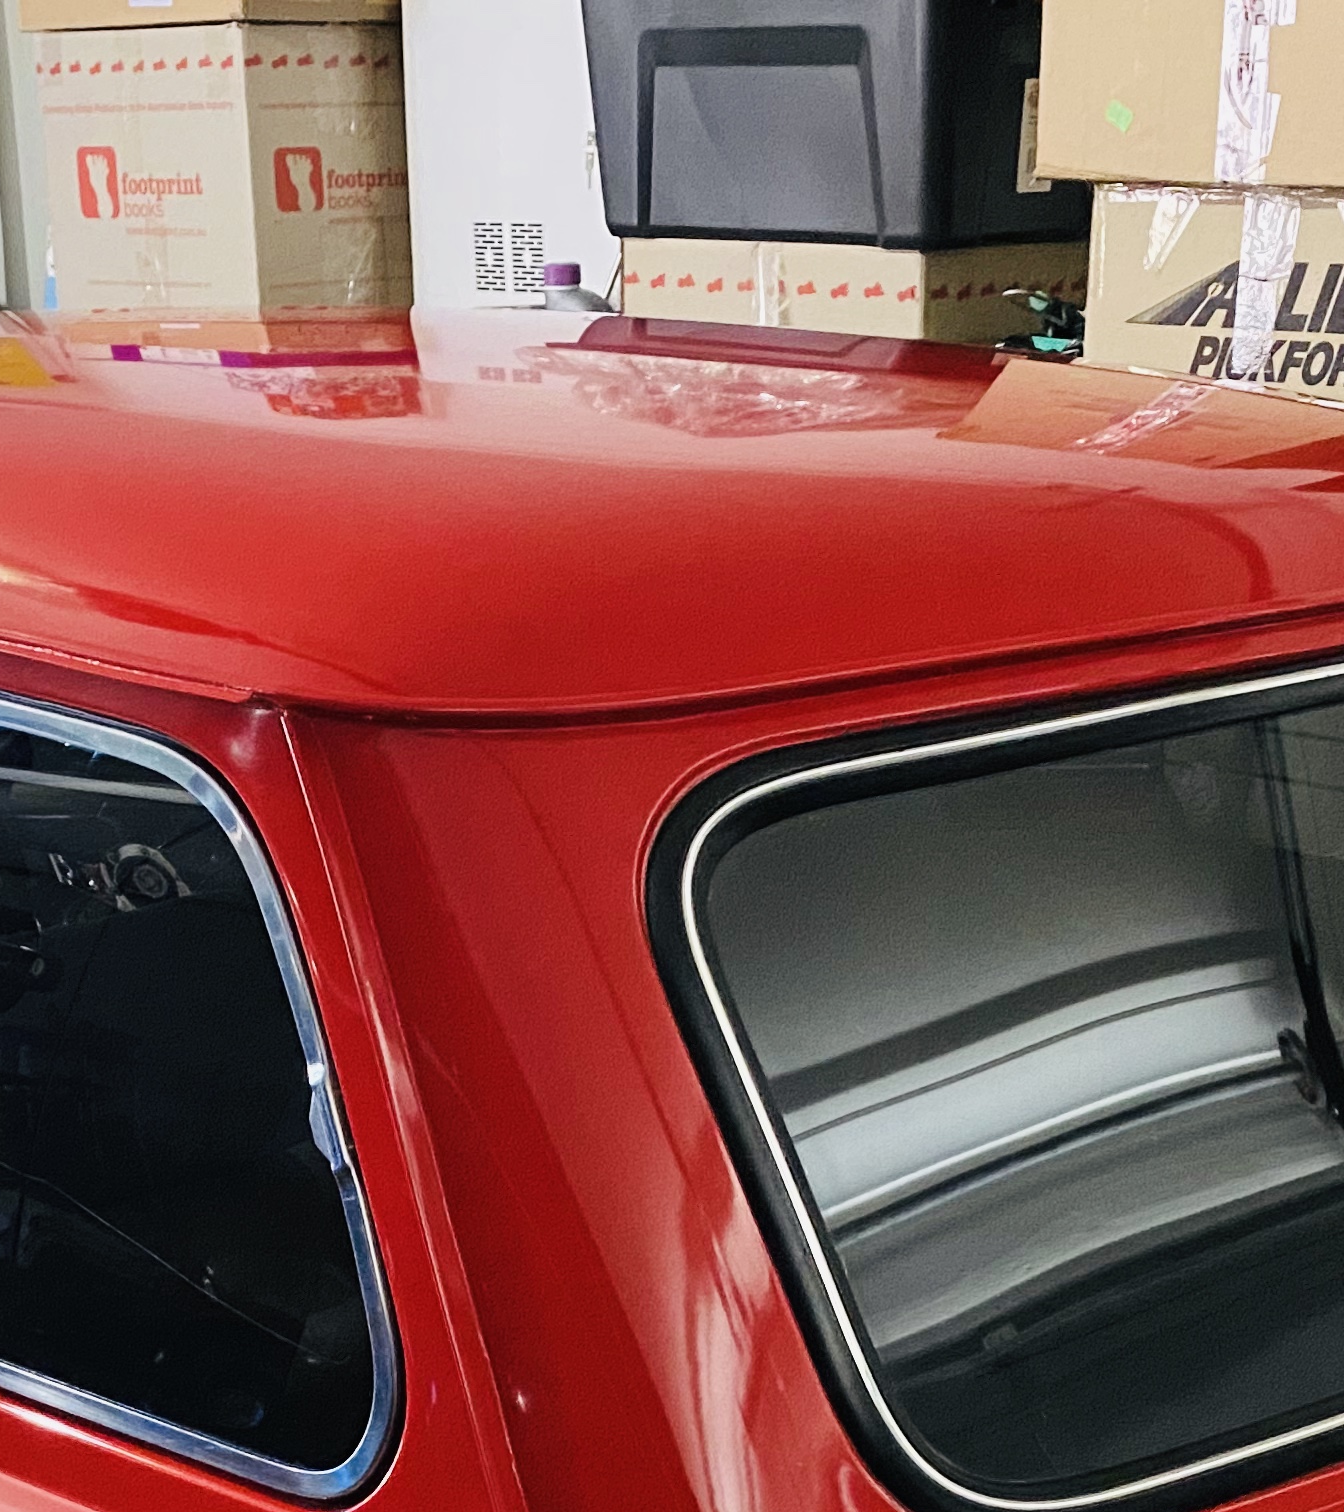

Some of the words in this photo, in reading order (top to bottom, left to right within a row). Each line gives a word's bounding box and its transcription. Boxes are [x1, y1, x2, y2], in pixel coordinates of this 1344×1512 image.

[122, 172, 204, 200] footprint
[327, 168, 407, 192] footprin
[124, 201, 165, 218] books
